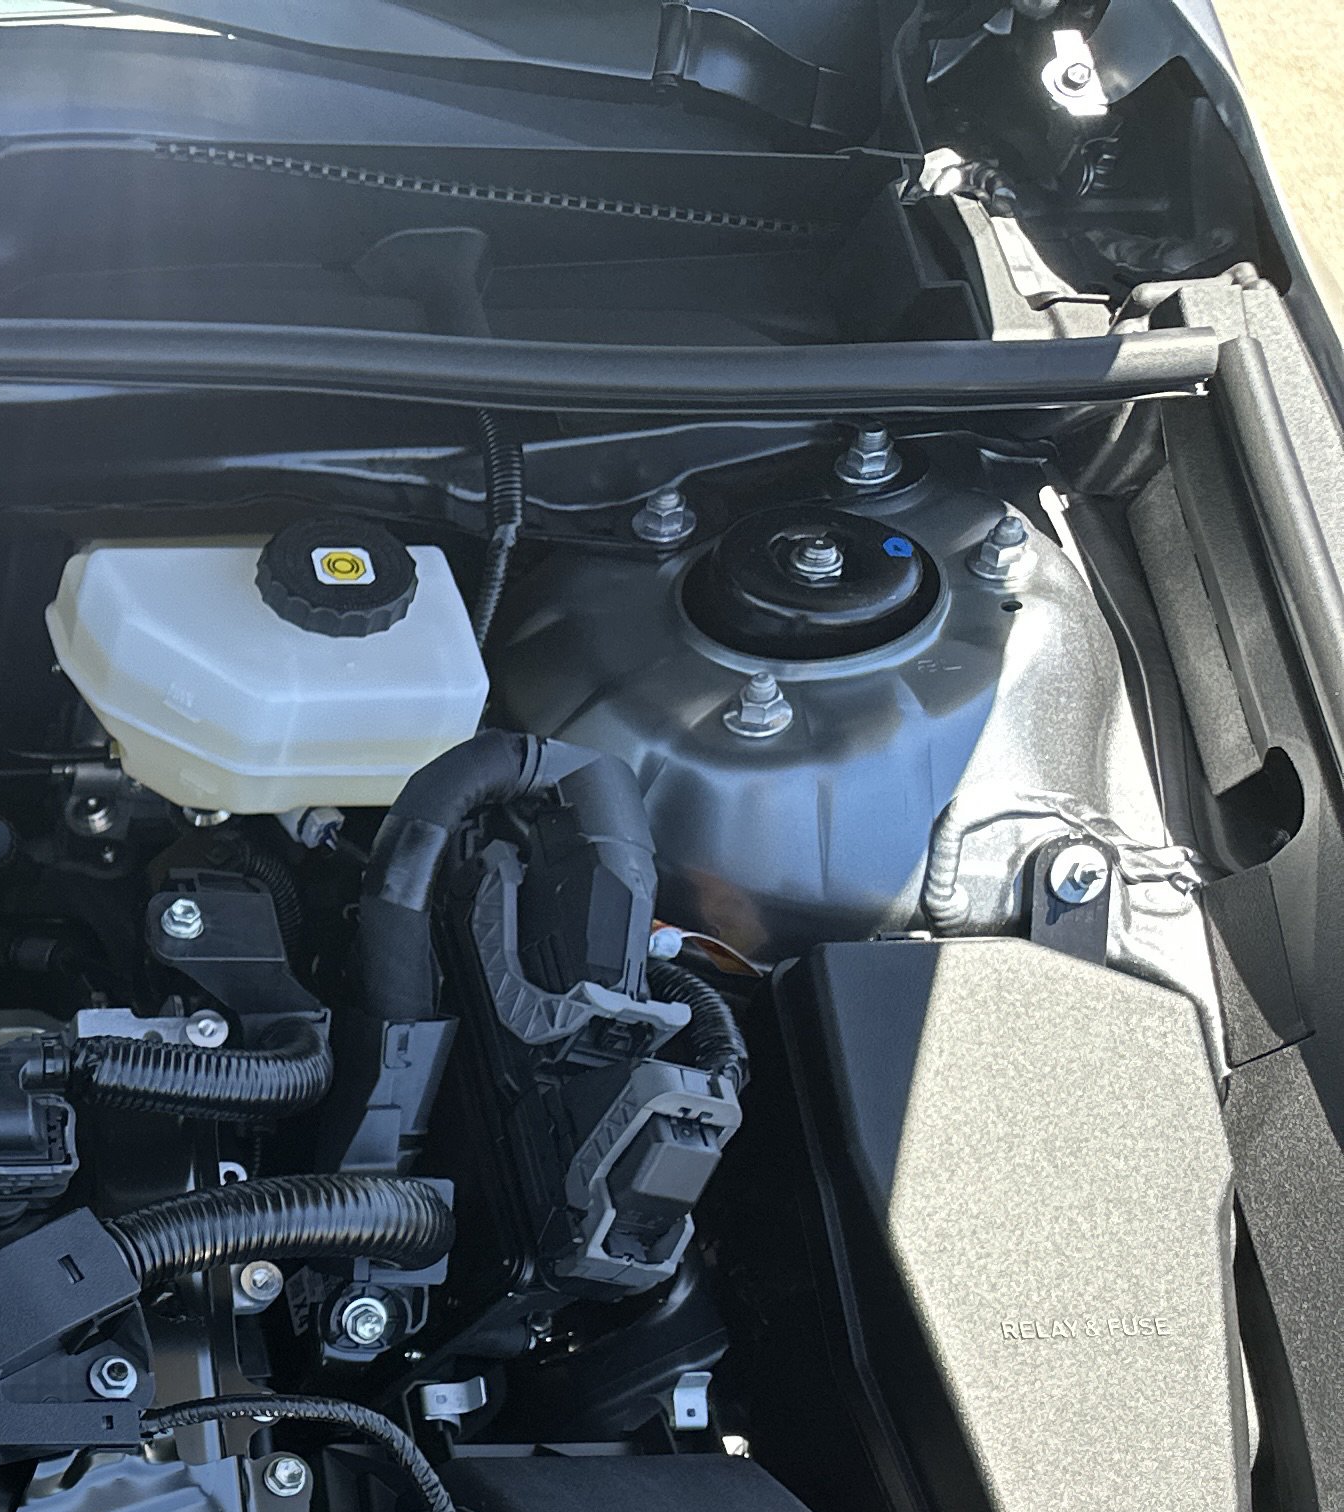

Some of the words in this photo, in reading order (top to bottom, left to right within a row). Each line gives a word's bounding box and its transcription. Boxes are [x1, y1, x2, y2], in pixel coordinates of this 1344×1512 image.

[1000, 1319, 1079, 1341] RELAY
[1085, 1320, 1100, 1338] &
[1107, 1317, 1172, 1337] FUSE
